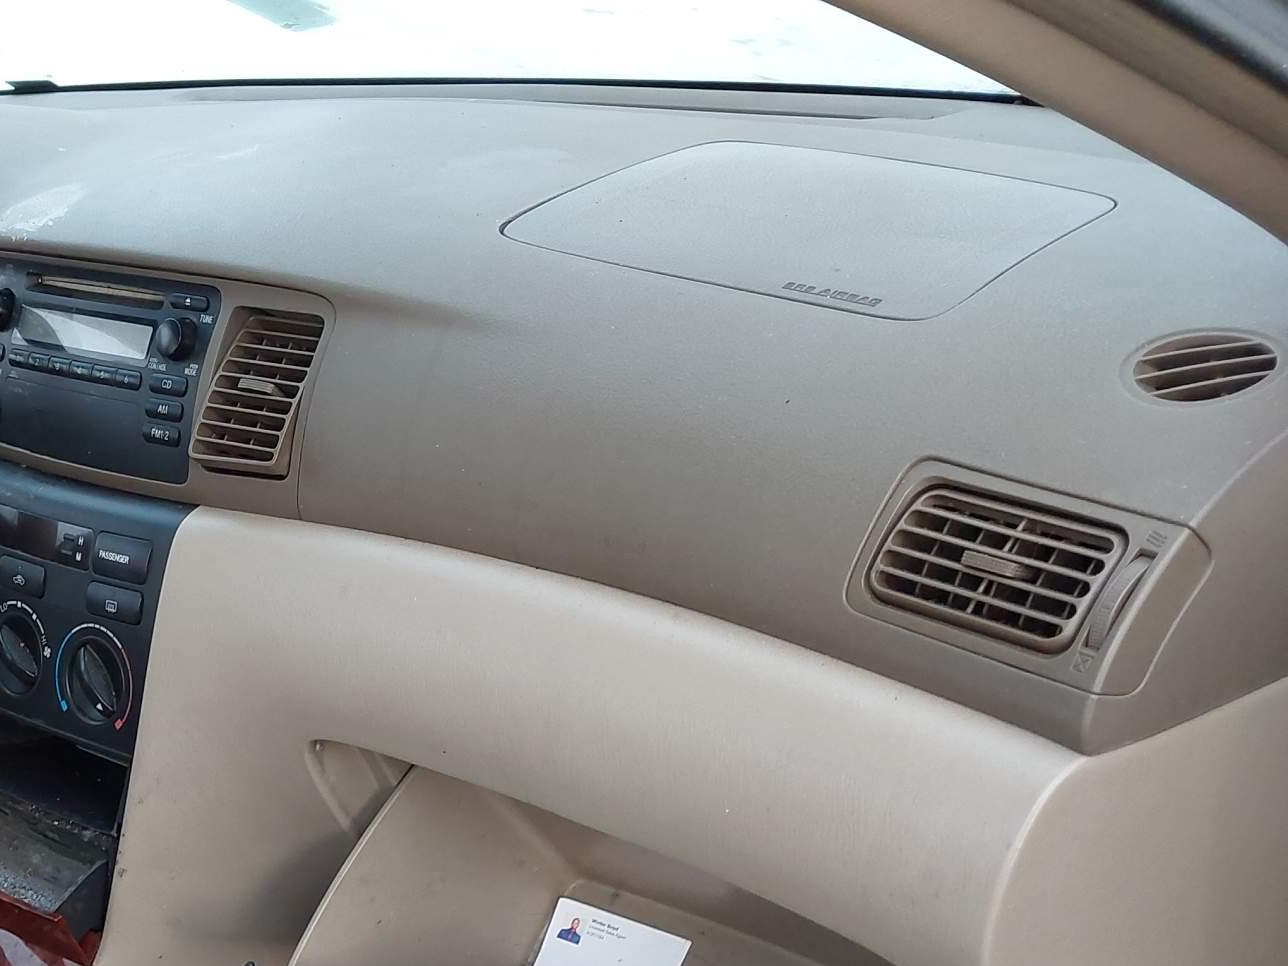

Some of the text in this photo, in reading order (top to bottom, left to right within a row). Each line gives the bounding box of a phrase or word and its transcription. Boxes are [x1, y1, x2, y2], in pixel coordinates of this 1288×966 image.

[816, 288, 883, 307] AIRBAG
[199, 313, 214, 324] TUNE
[161, 378, 172, 390] CD
[157, 404, 169, 415] AM
[78, 535, 84, 546] H
[98, 549, 130, 565] PASSENGER
